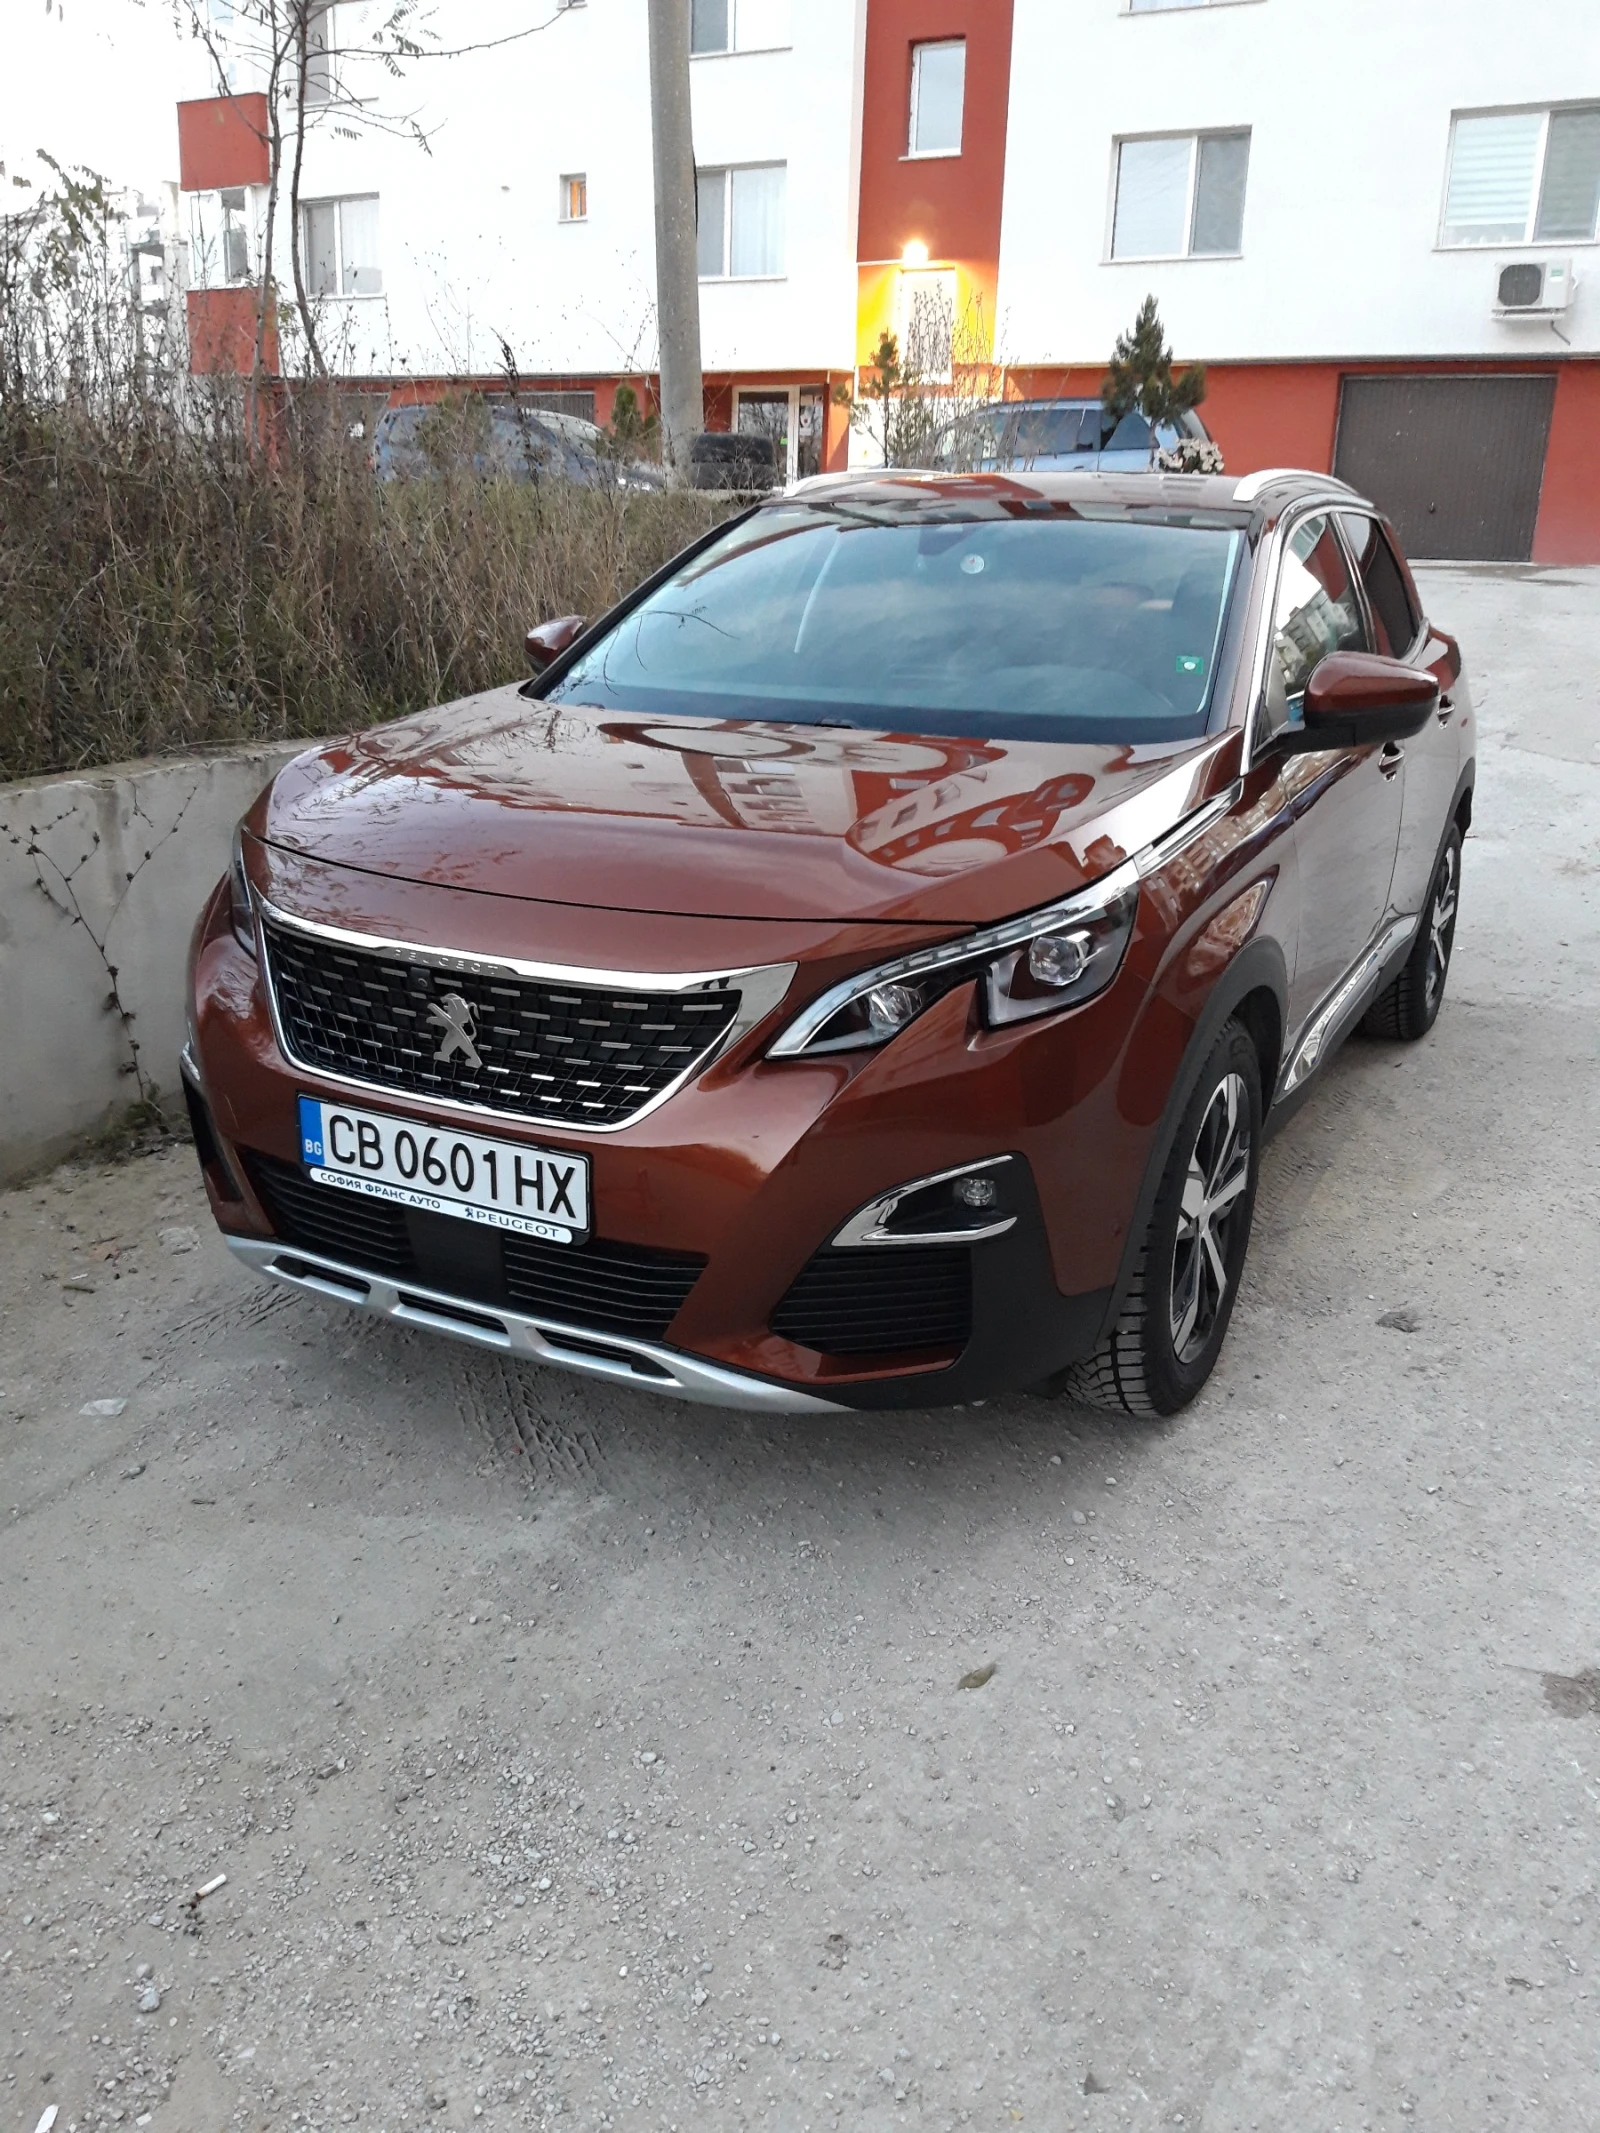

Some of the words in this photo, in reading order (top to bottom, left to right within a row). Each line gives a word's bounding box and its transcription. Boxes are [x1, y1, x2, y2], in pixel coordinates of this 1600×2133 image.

[304, 1138, 323, 1156] BG
[329, 1114, 384, 1171] CB
[394, 1130, 499, 1201] 0601
[514, 1155, 577, 1220] HX
[320, 1172, 362, 1190] СОФИЯ
[364, 1183, 407, 1201] ФРАНС
[409, 1194, 441, 1210] АУТО
[475, 1210, 560, 1239] PEUGEOT
